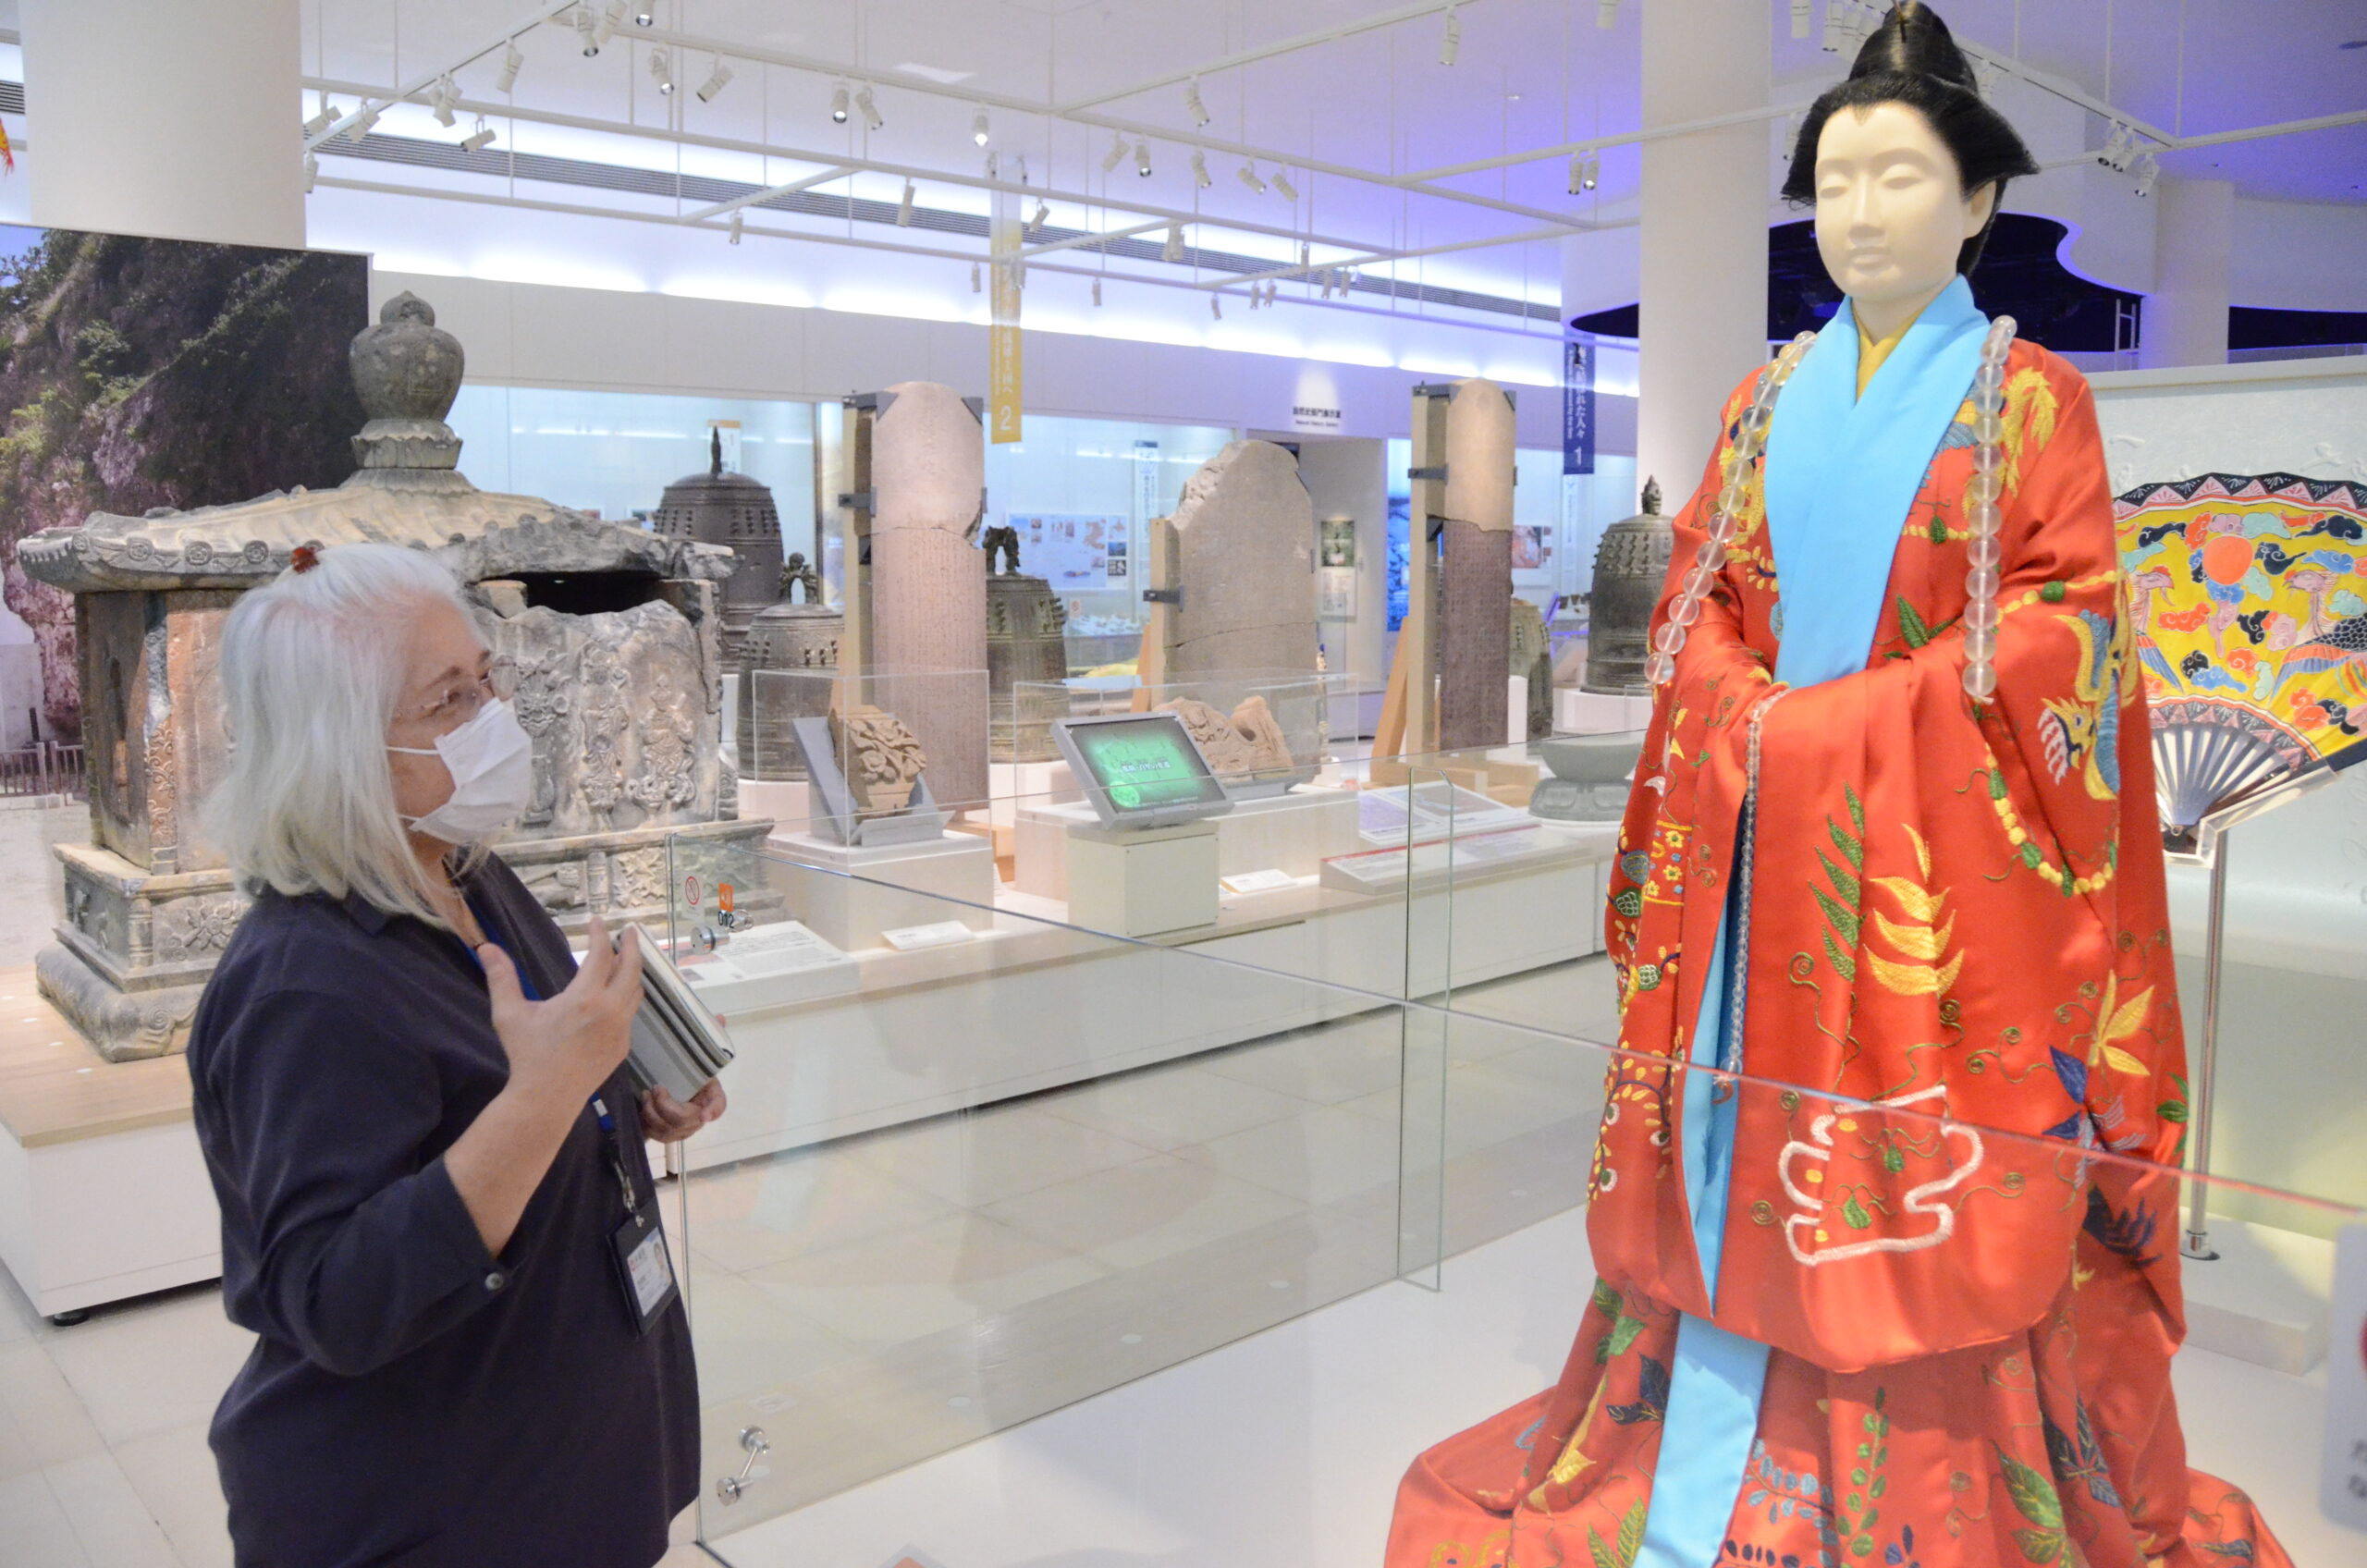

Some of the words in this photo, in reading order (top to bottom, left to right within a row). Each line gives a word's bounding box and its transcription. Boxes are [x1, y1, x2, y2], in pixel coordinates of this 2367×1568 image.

[1000, 406, 1012, 431] 2
[1574, 446, 1582, 466] 1
[717, 911, 735, 928] 012
